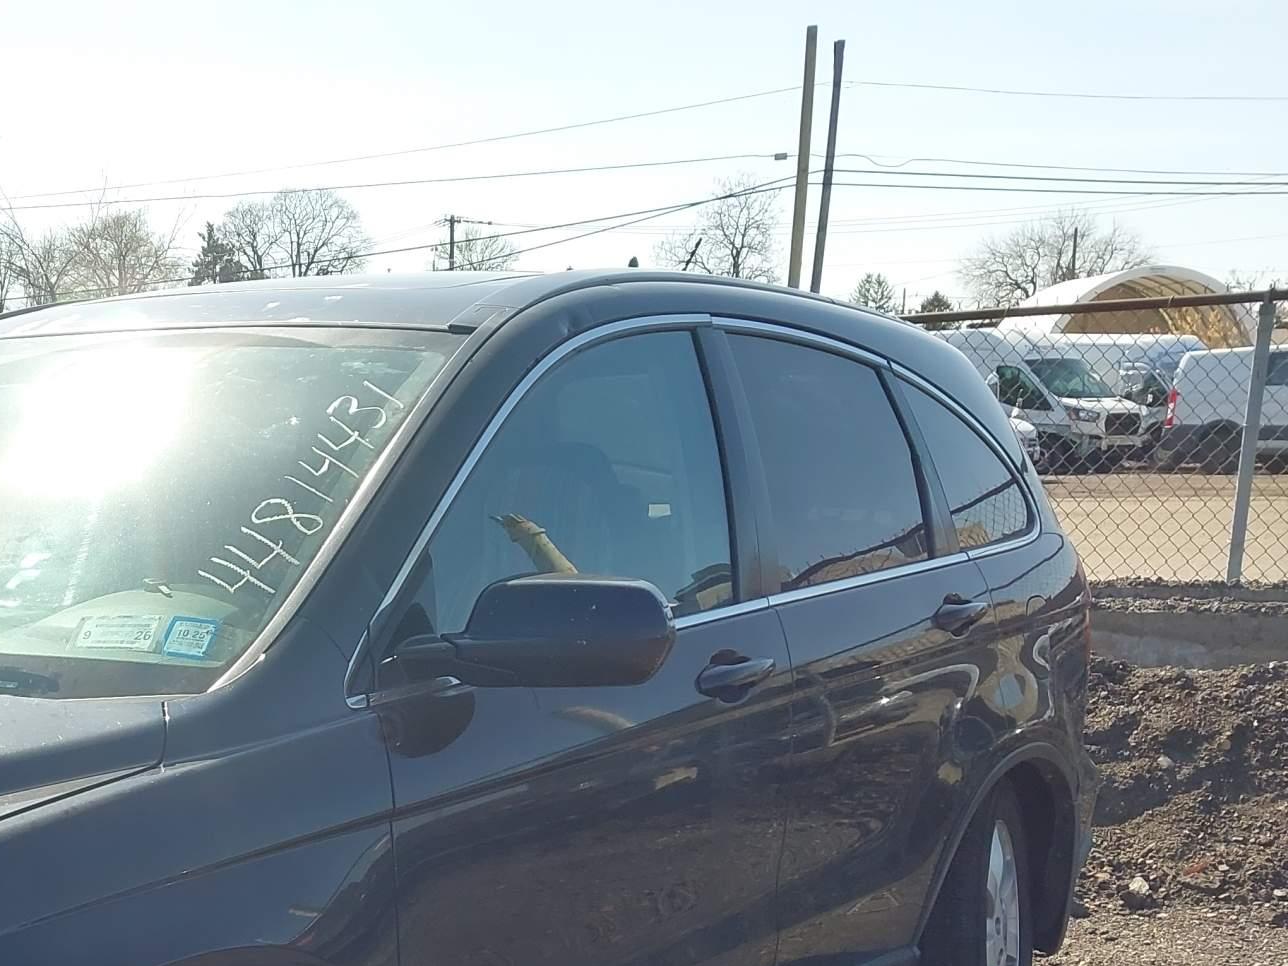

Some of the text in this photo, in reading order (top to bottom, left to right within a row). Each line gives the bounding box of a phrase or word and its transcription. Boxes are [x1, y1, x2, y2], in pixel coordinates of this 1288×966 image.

[197, 380, 405, 594] 44814431
[82, 630, 152, 641] 9 26
[177, 629, 190, 637] 10
